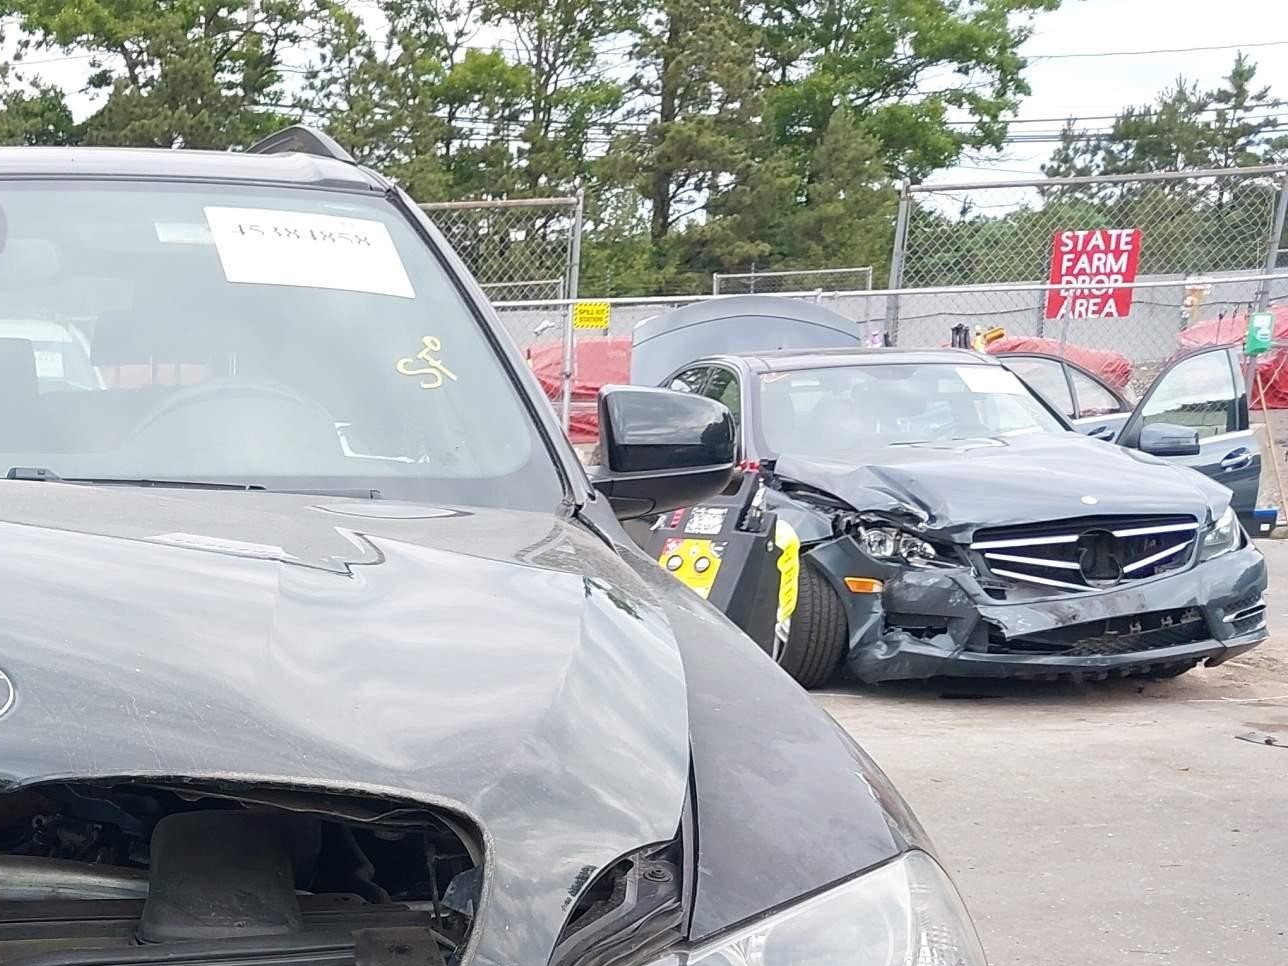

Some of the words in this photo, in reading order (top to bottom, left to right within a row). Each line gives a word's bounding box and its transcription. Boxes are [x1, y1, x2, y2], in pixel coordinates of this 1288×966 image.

[1059, 229, 1134, 252] STATE
[1061, 252, 1129, 275] FARM
[1060, 274, 1124, 296] DROP
[1056, 298, 1119, 320] AREA
